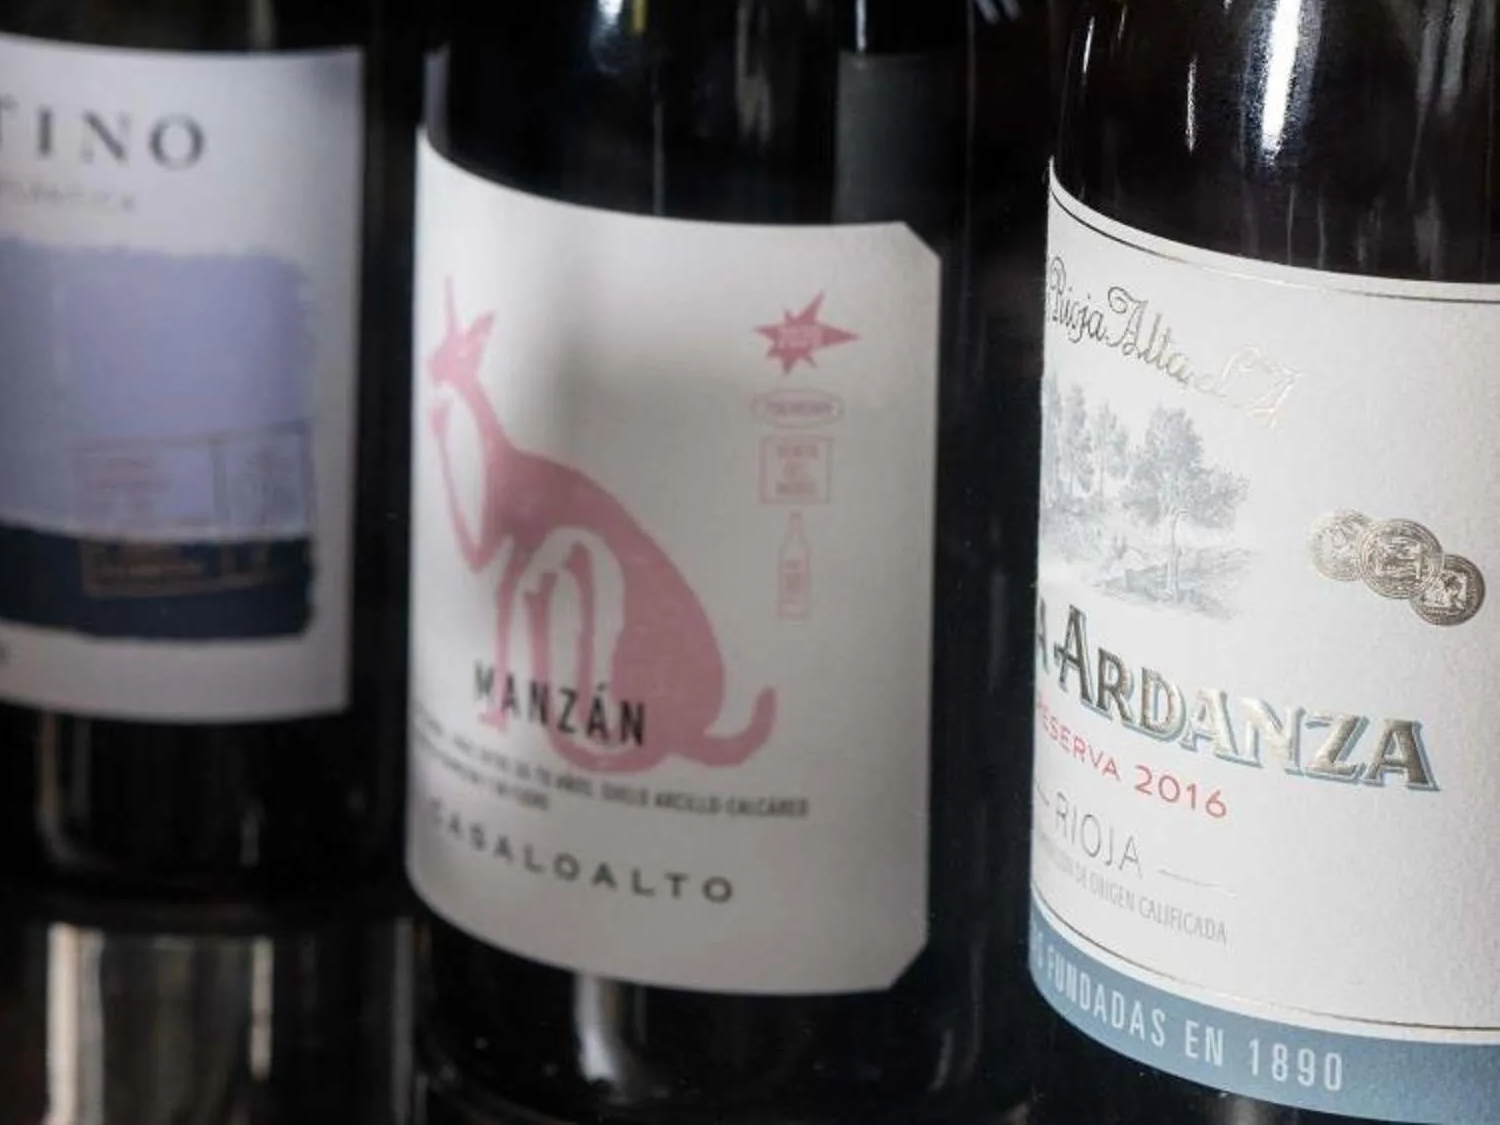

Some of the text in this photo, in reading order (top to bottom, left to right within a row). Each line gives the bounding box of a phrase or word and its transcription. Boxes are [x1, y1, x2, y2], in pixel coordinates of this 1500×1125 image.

[474, 660, 646, 748] MANZÁN
[1053, 604, 1442, 793] ARDANZA
[1055, 791, 1144, 879] RIOJA
[1134, 764, 1228, 819] 2016
[1089, 871, 1135, 912] ORIGEN
[1138, 895, 1228, 946] CALIFICADA
[1047, 945, 1167, 1048] FUNDADAS
[1185, 1020, 1225, 1067] EN
[1249, 1038, 1344, 1092] 1890
